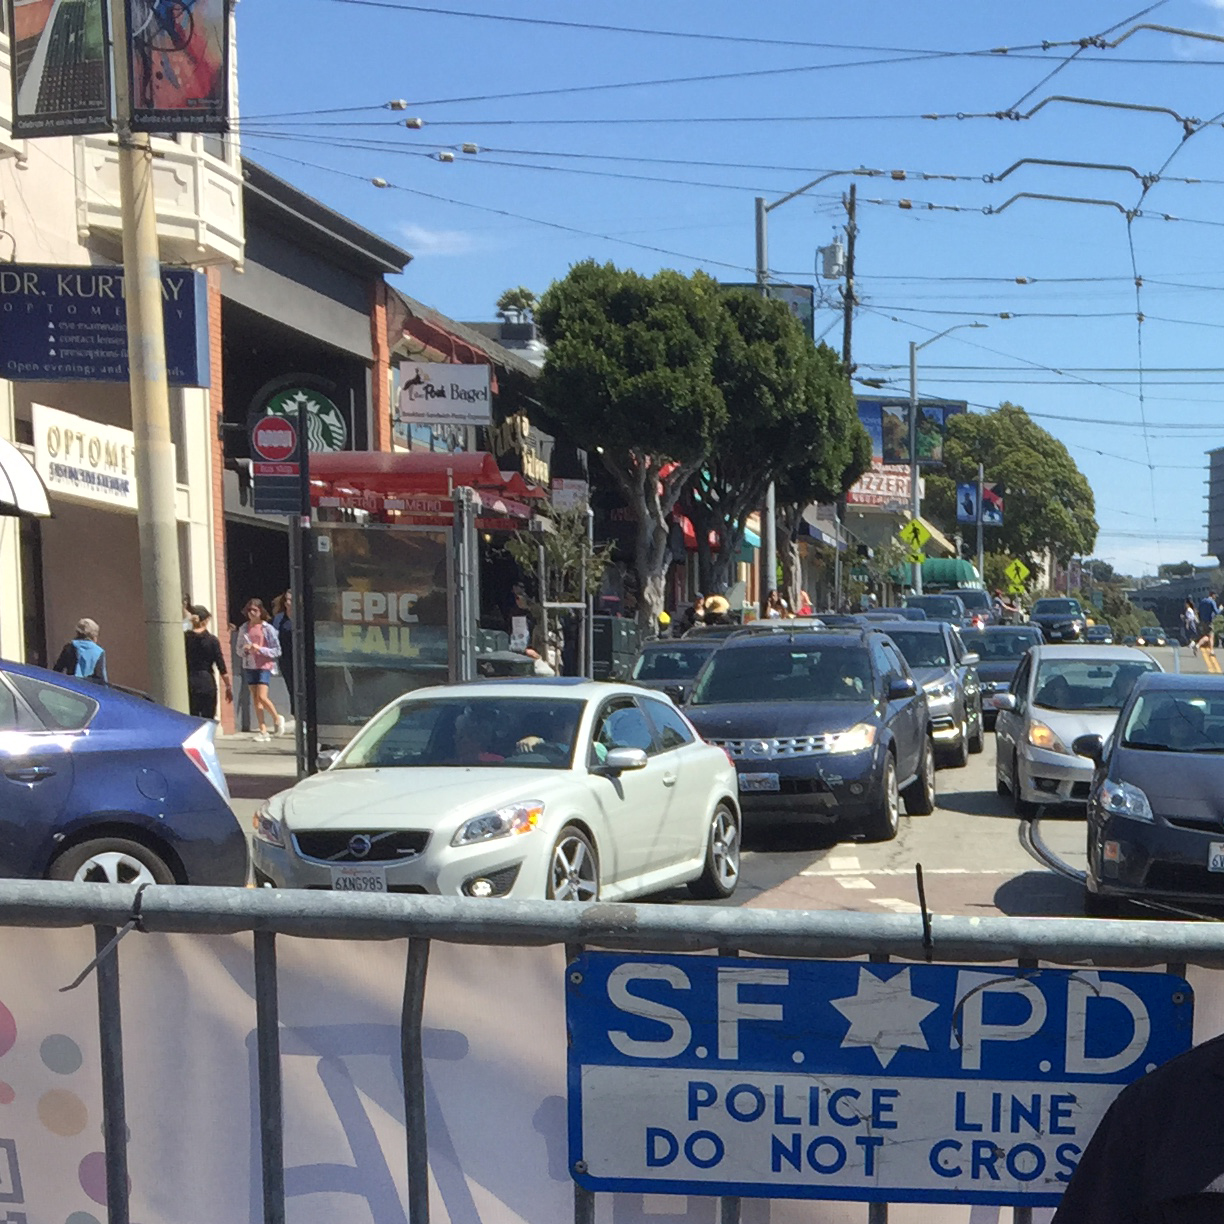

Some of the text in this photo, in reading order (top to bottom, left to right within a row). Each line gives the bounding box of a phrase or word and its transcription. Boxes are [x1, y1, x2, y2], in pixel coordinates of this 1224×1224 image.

[0, 272, 46, 296] DR.
[3, 303, 184, 319] OPTOMEY
[7, 361, 40, 374] Open
[44, 363, 96, 376] evenings
[101, 364, 122, 375] and
[450, 383, 488, 402] Bagel
[47, 425, 135, 475] OPTOME
[859, 475, 912, 495] IZZERI
[404, 500, 442, 511] METRO
[341, 591, 419, 623] EPIC
[341, 624, 420, 658] FAIL
[606, 962, 805, 1064] S.F.
[687, 1081, 1078, 1135] POLICE LINE
[646, 1128, 1083, 1182] DO NOT CROS
